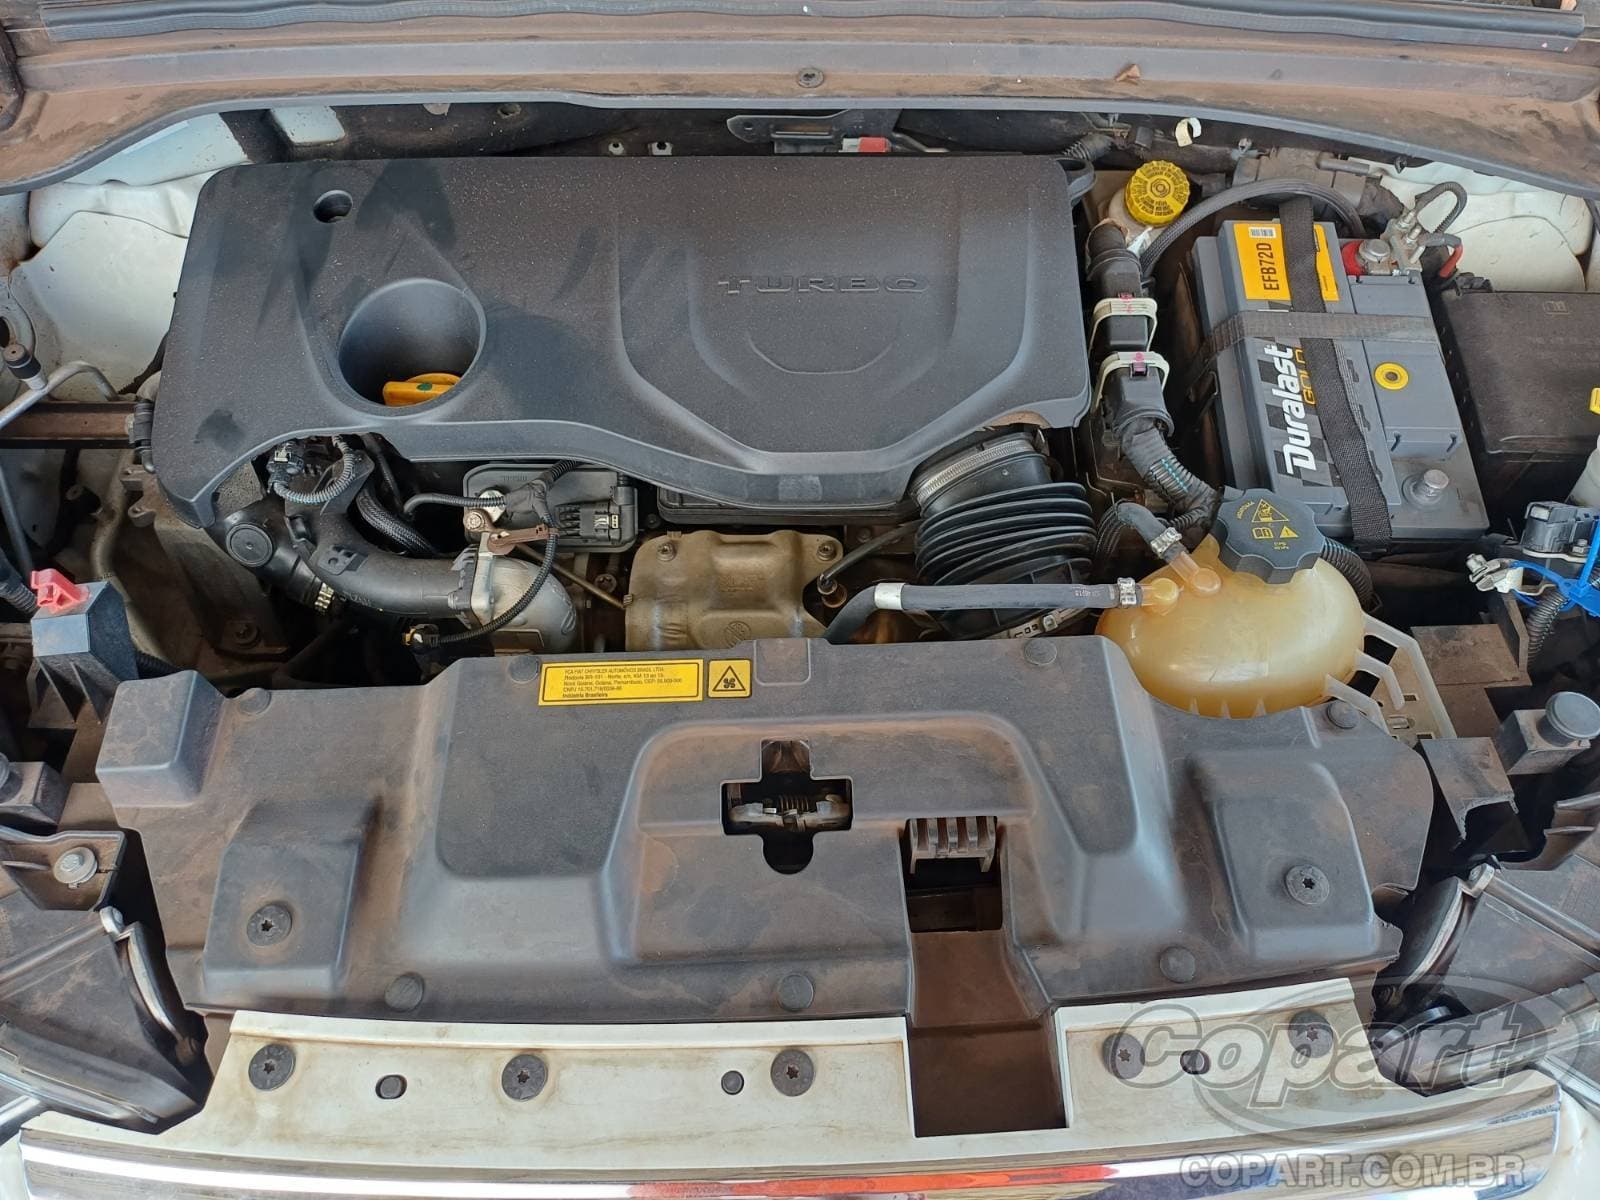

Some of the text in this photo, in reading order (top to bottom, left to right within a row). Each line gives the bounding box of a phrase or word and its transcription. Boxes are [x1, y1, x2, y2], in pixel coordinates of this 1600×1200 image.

[717, 276, 930, 294] TURBO
[1256, 242, 1280, 291] EFB72D
[1264, 343, 1317, 475] Duralast
